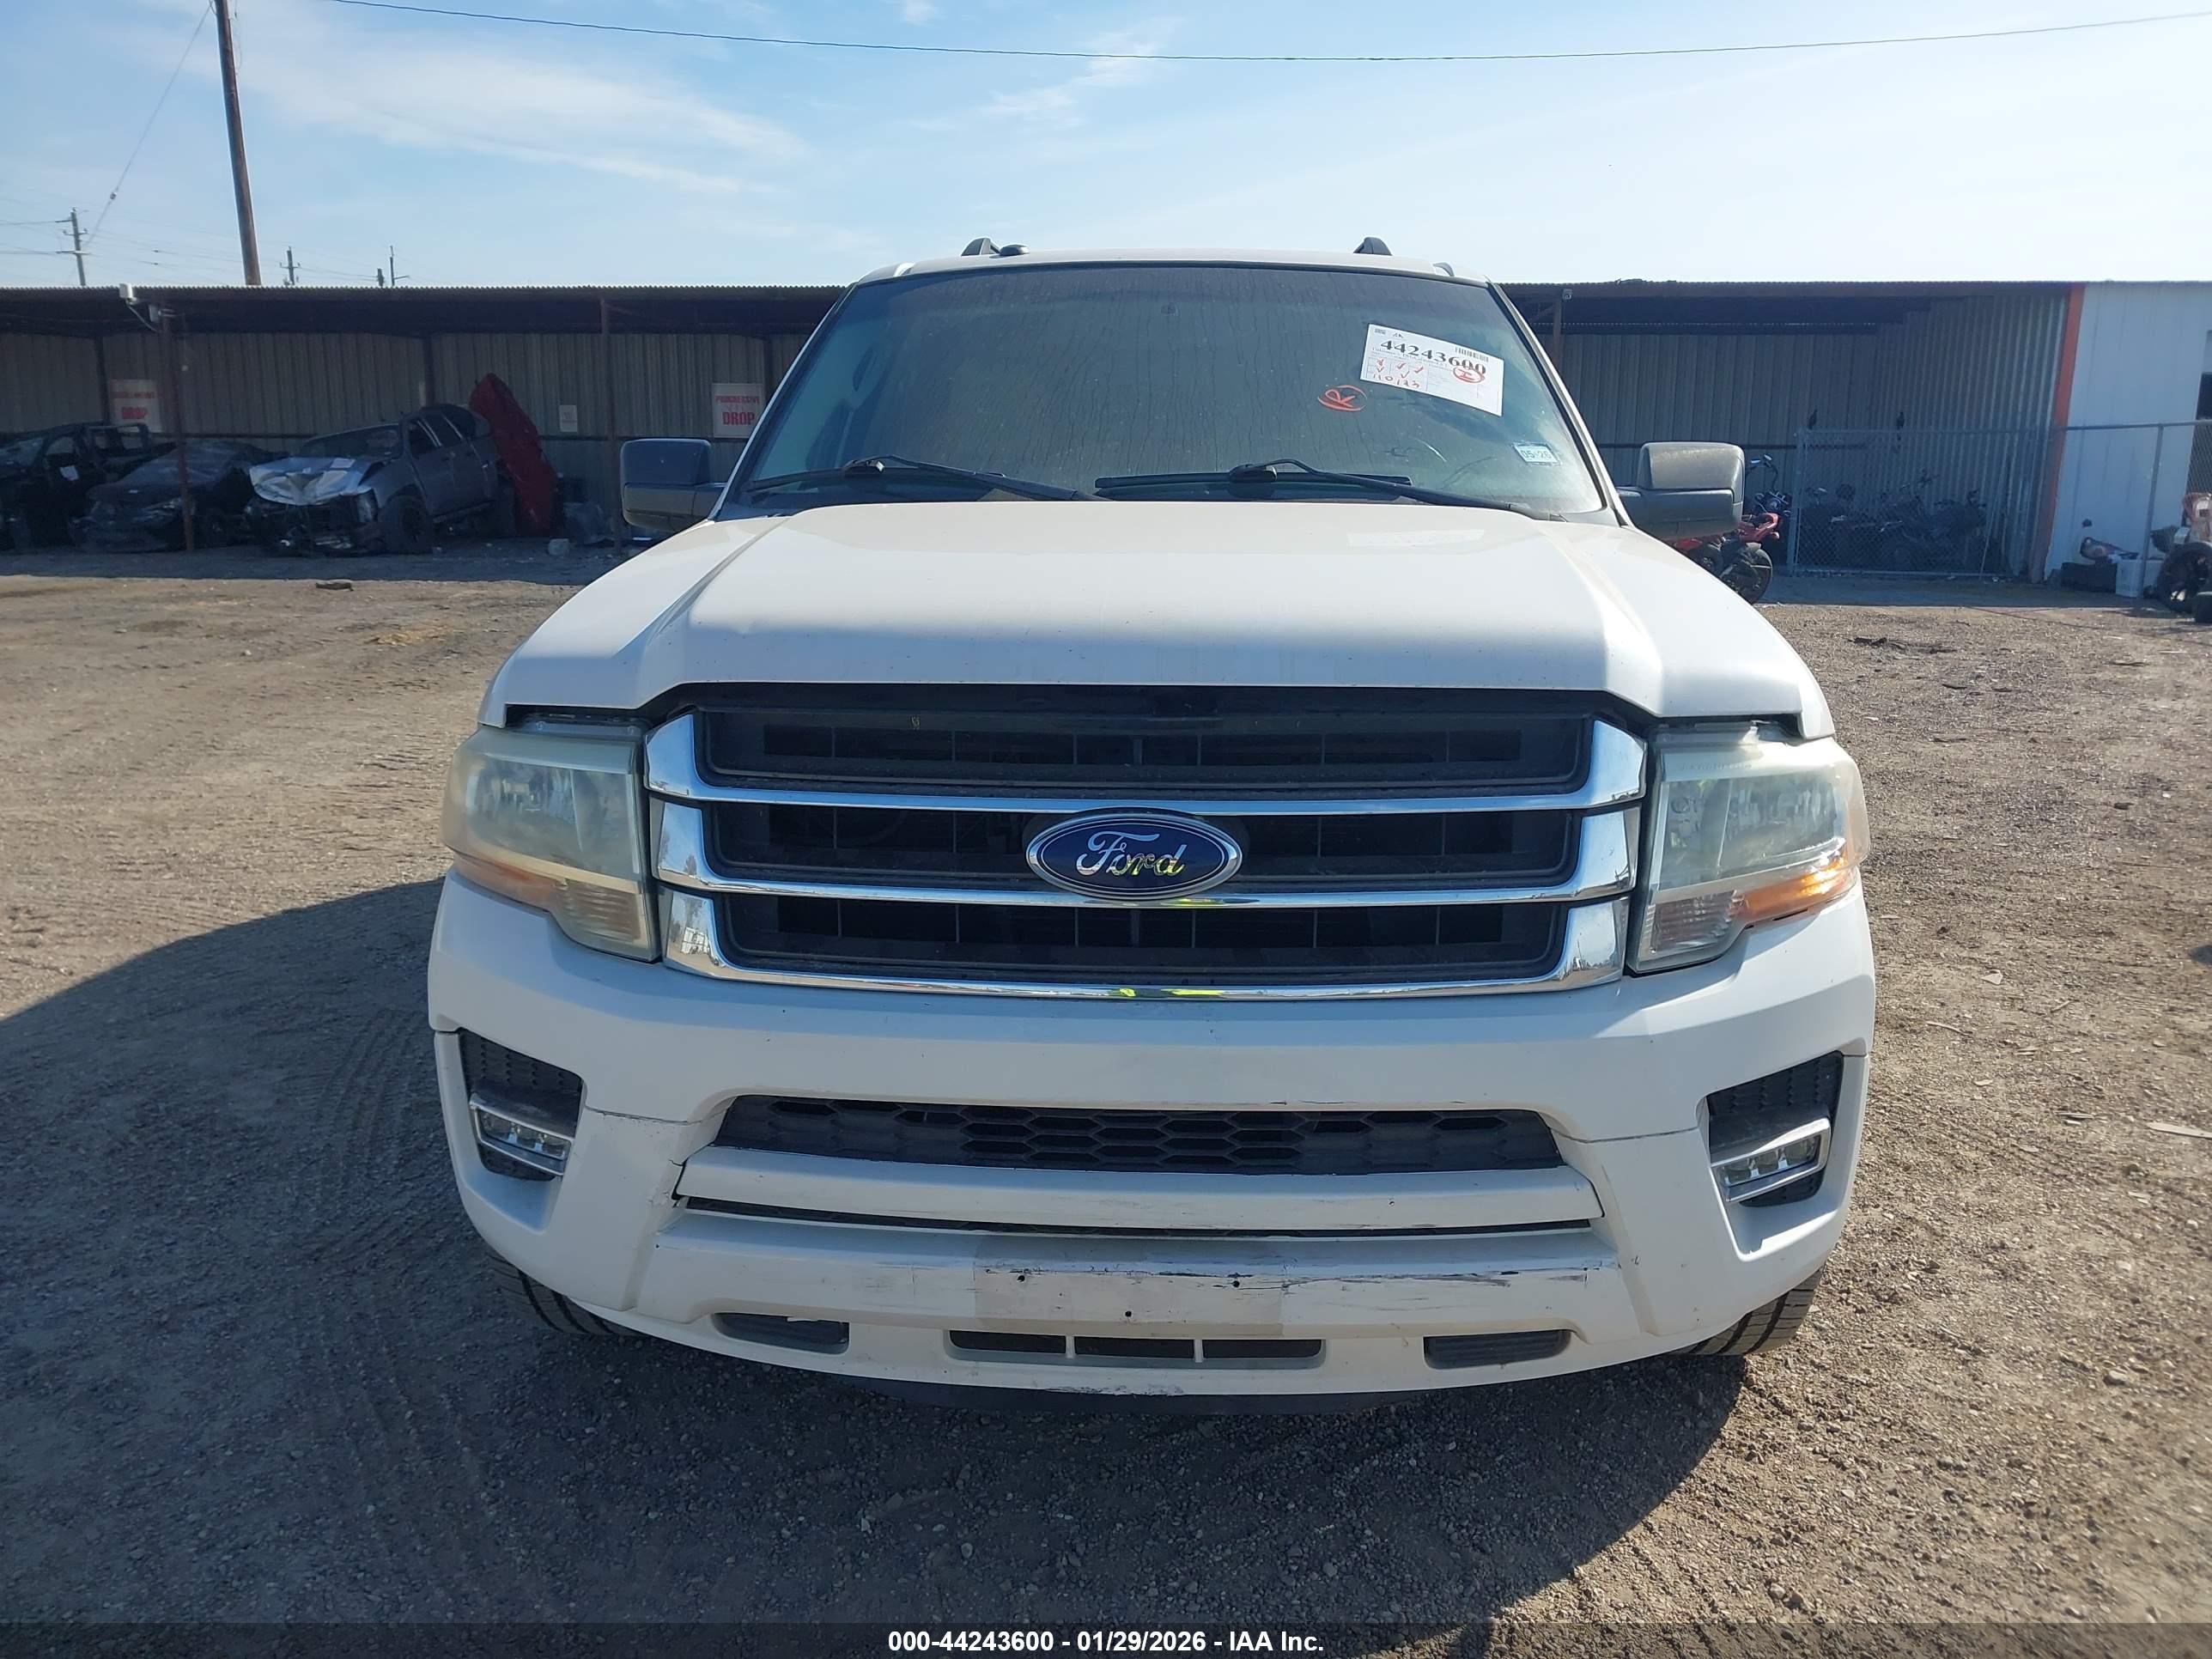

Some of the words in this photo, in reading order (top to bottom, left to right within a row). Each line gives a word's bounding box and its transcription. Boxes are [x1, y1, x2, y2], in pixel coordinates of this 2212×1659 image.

[1381, 341, 1486, 374] 44243600
[722, 412, 756, 425] DROP
[1076, 830, 1188, 876] Ford
